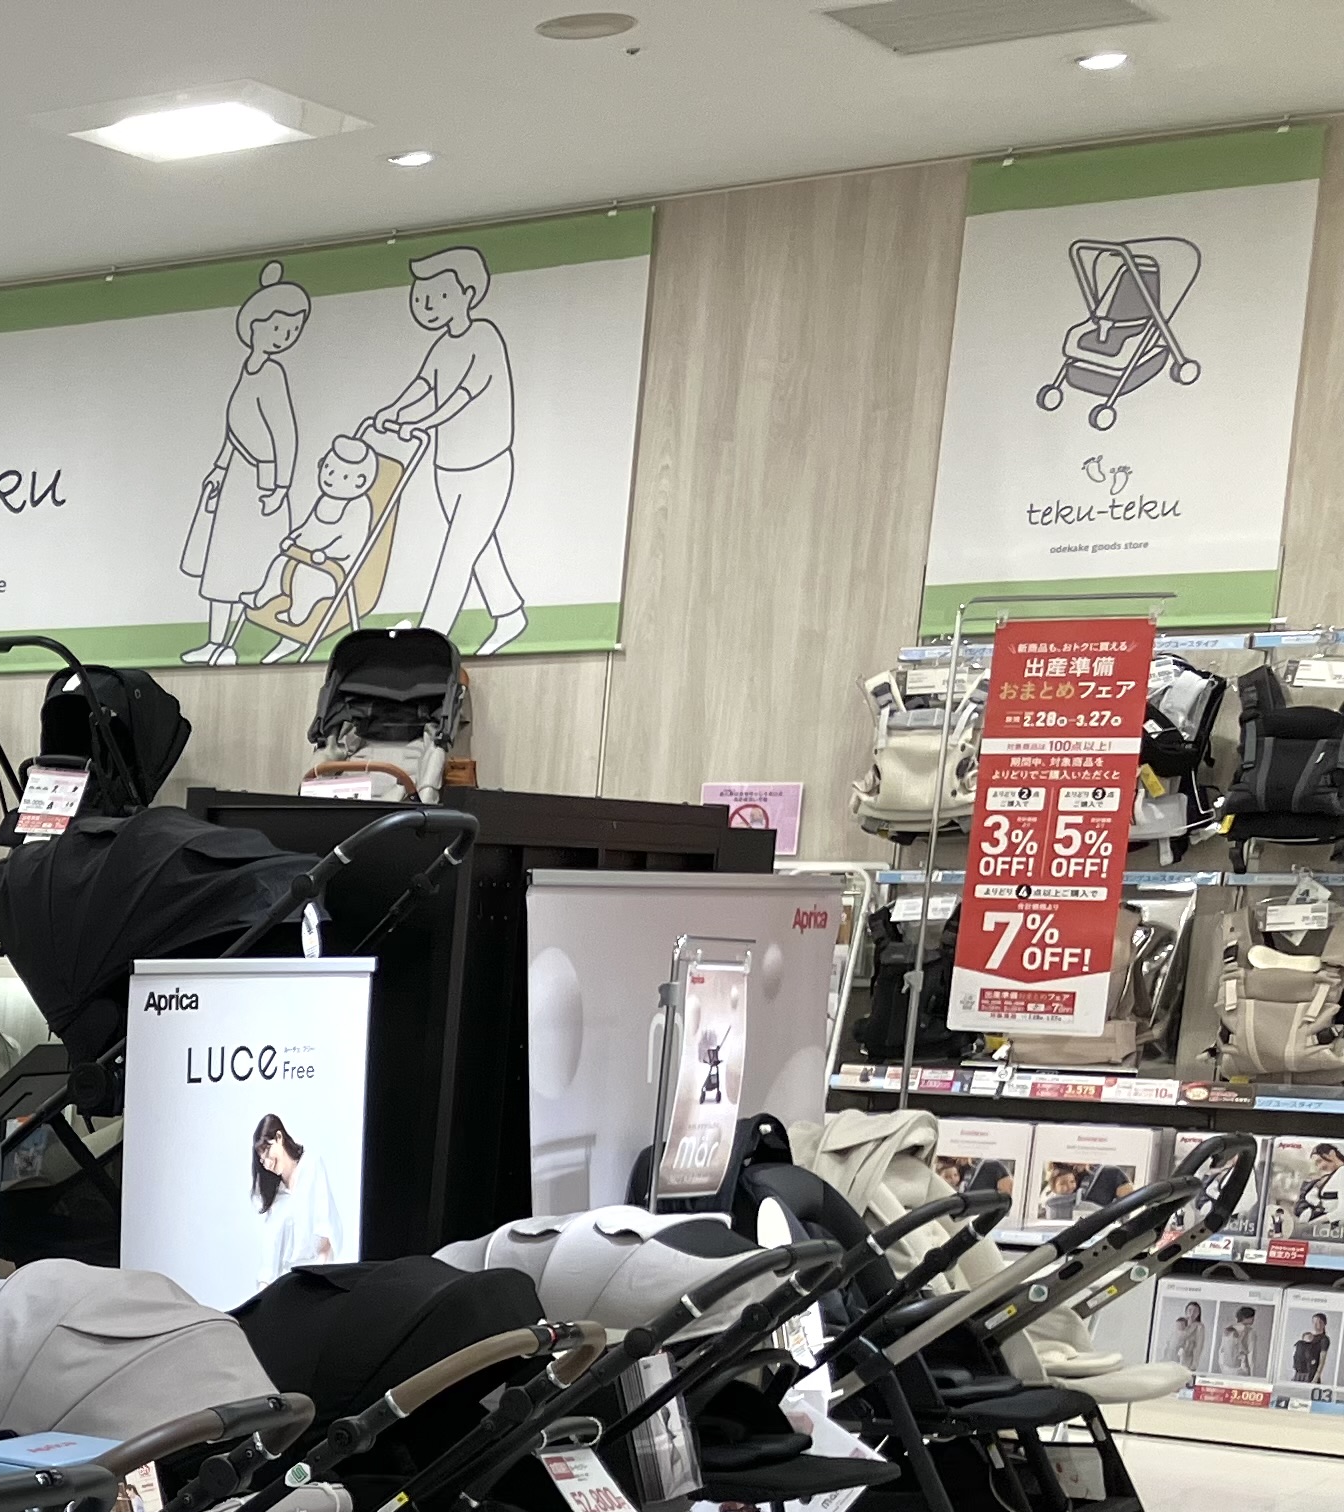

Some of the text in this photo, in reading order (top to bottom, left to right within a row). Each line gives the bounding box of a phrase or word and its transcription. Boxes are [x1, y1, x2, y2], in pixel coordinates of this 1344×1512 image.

[1026, 494, 1182, 527] teku-teku
[1049, 539, 1150, 556] odekake goods store
[1017, 640, 1129, 654] 新商品も、おトクに買える
[1023, 655, 1116, 679] 出産準備
[998, 680, 1137, 701] おまとめフェア
[1009, 756, 1106, 768] 期間中、対象商品を
[991, 769, 1121, 781] よりどりでご購入いただくと
[979, 814, 1039, 856] 3%
[1052, 815, 1114, 857] 5%
[978, 856, 1035, 878] OFF!
[1050, 857, 1111, 879] OFF!
[791, 903, 829, 934] Aprica
[1021, 947, 1092, 972] OFF!
[143, 987, 200, 1016] Aprica
[281, 1060, 316, 1080] Free
